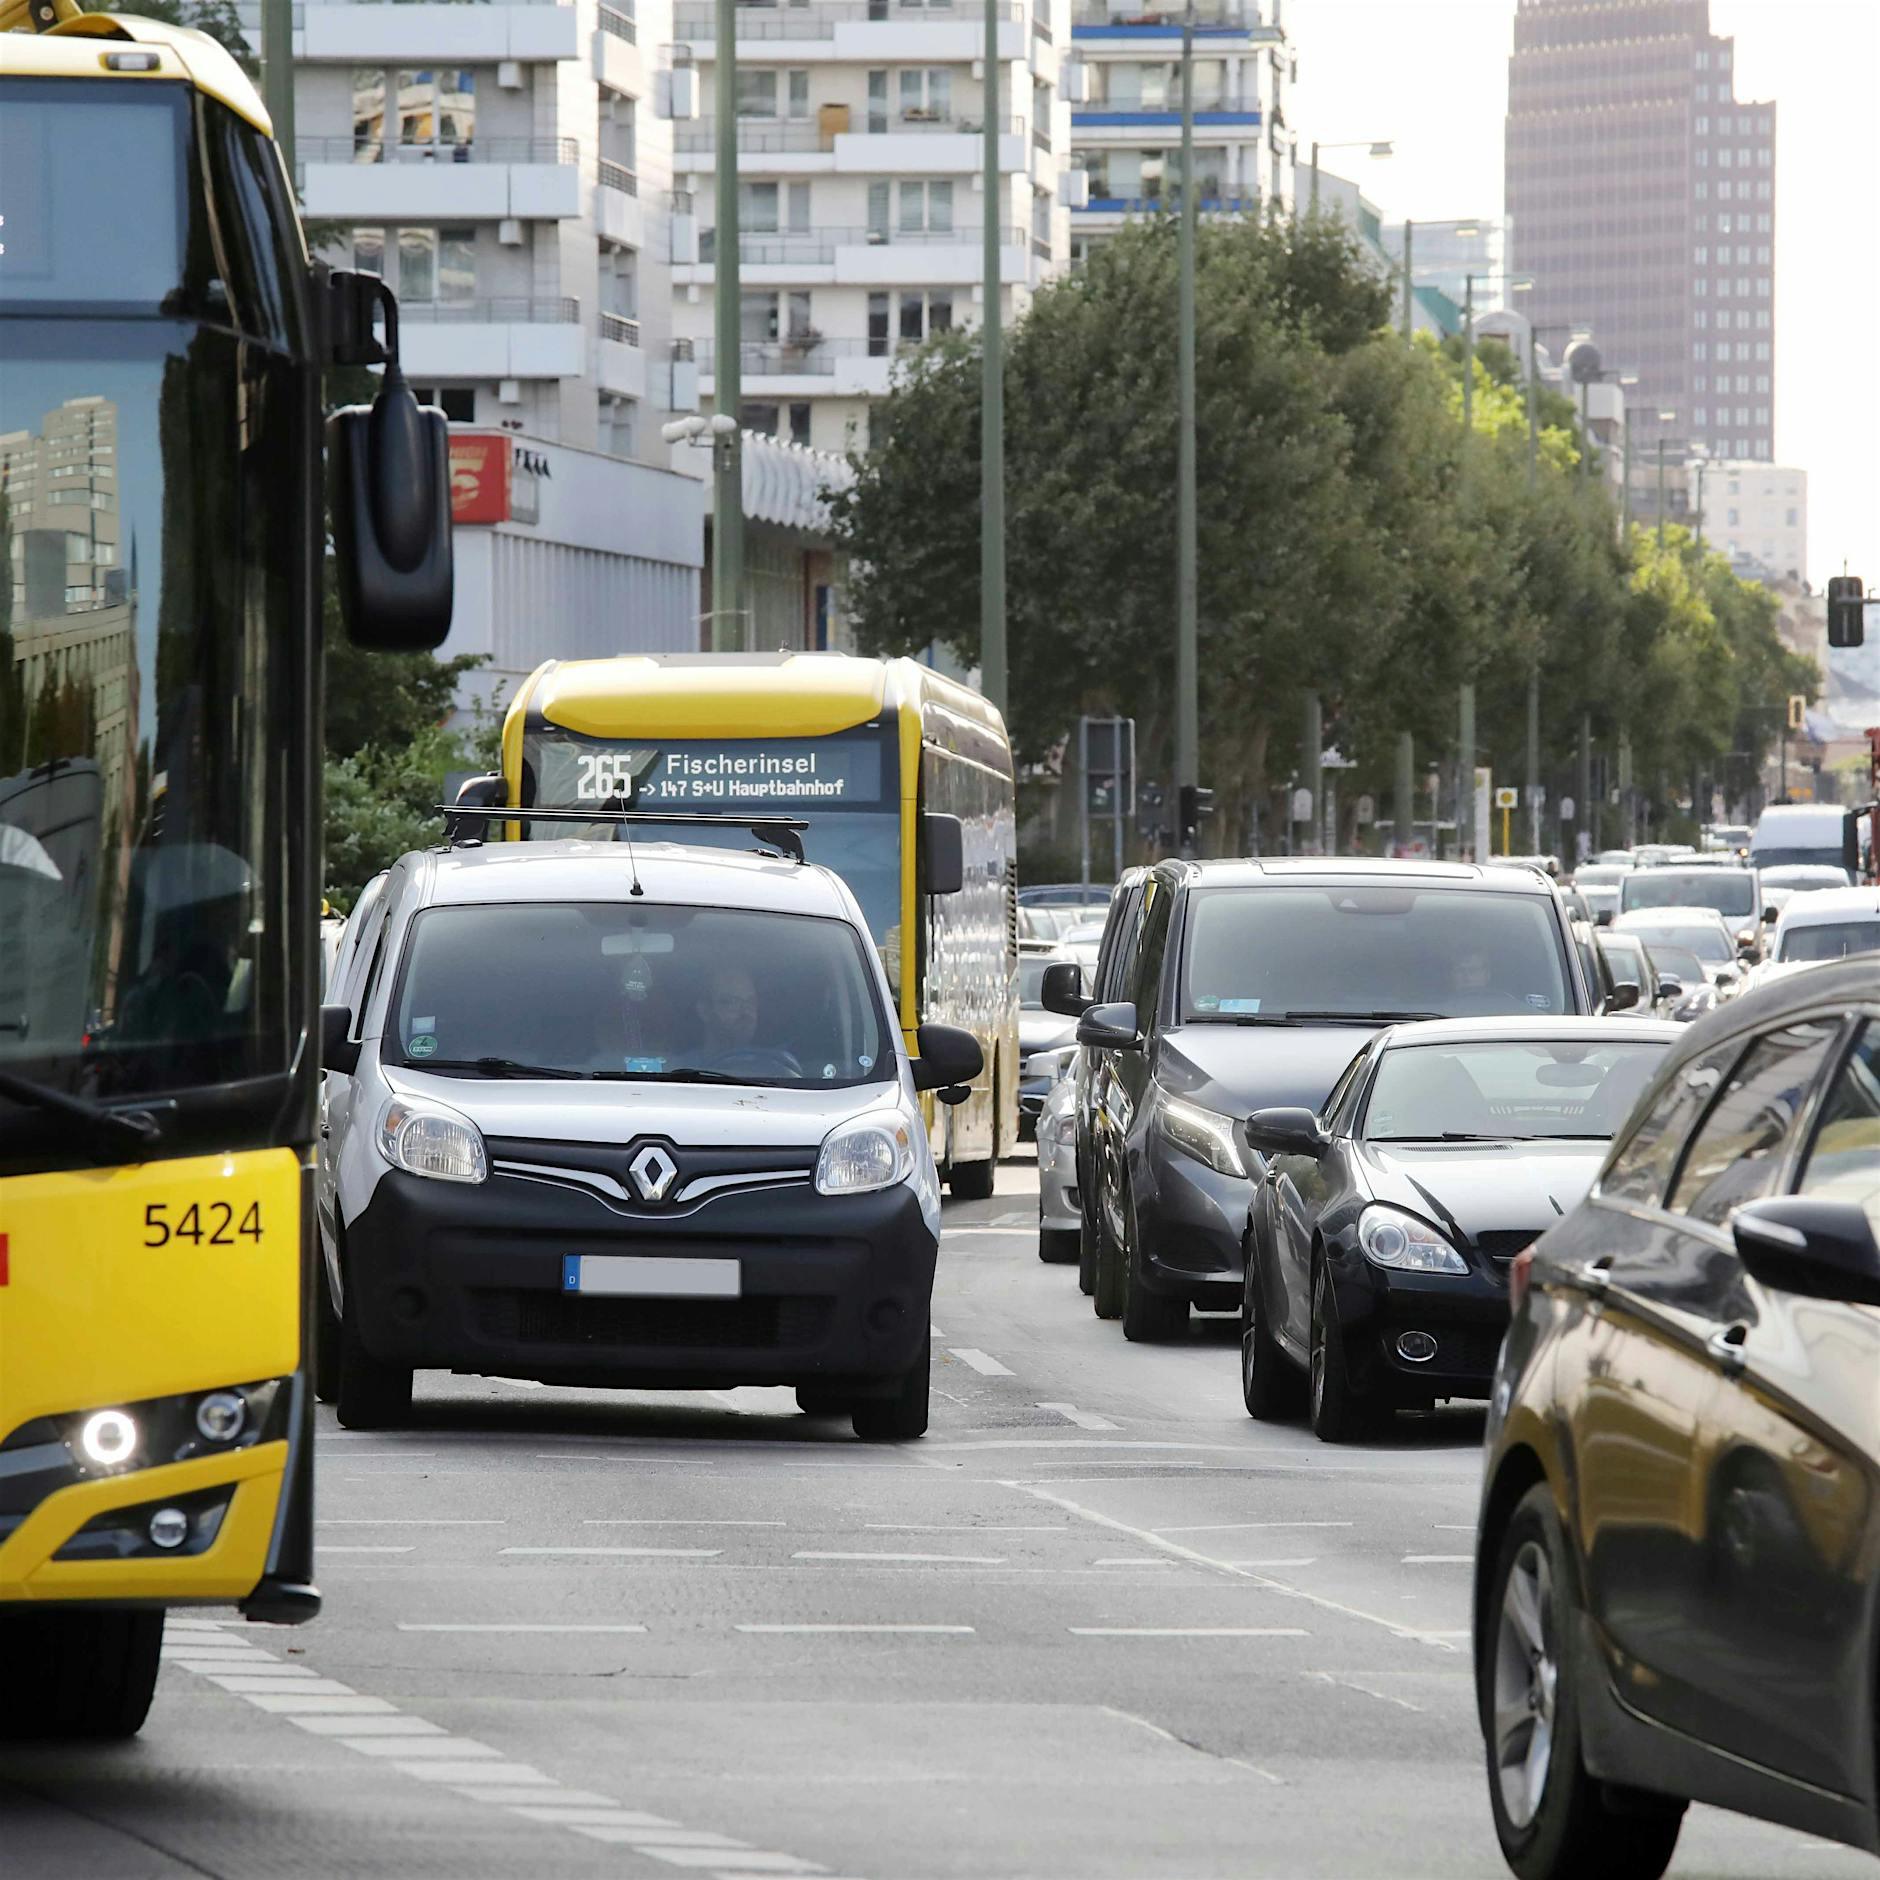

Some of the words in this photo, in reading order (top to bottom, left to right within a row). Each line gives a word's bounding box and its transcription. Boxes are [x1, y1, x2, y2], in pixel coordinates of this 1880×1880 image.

[667, 753, 815, 774] Fischerinsel
[577, 755, 631, 799] 265
[660, 780, 687, 796] 147
[692, 780, 723, 796] S+U
[728, 779, 844, 797] Hauptbahnhof
[144, 1201, 264, 1247] 5424
[568, 1275, 576, 1285] D
